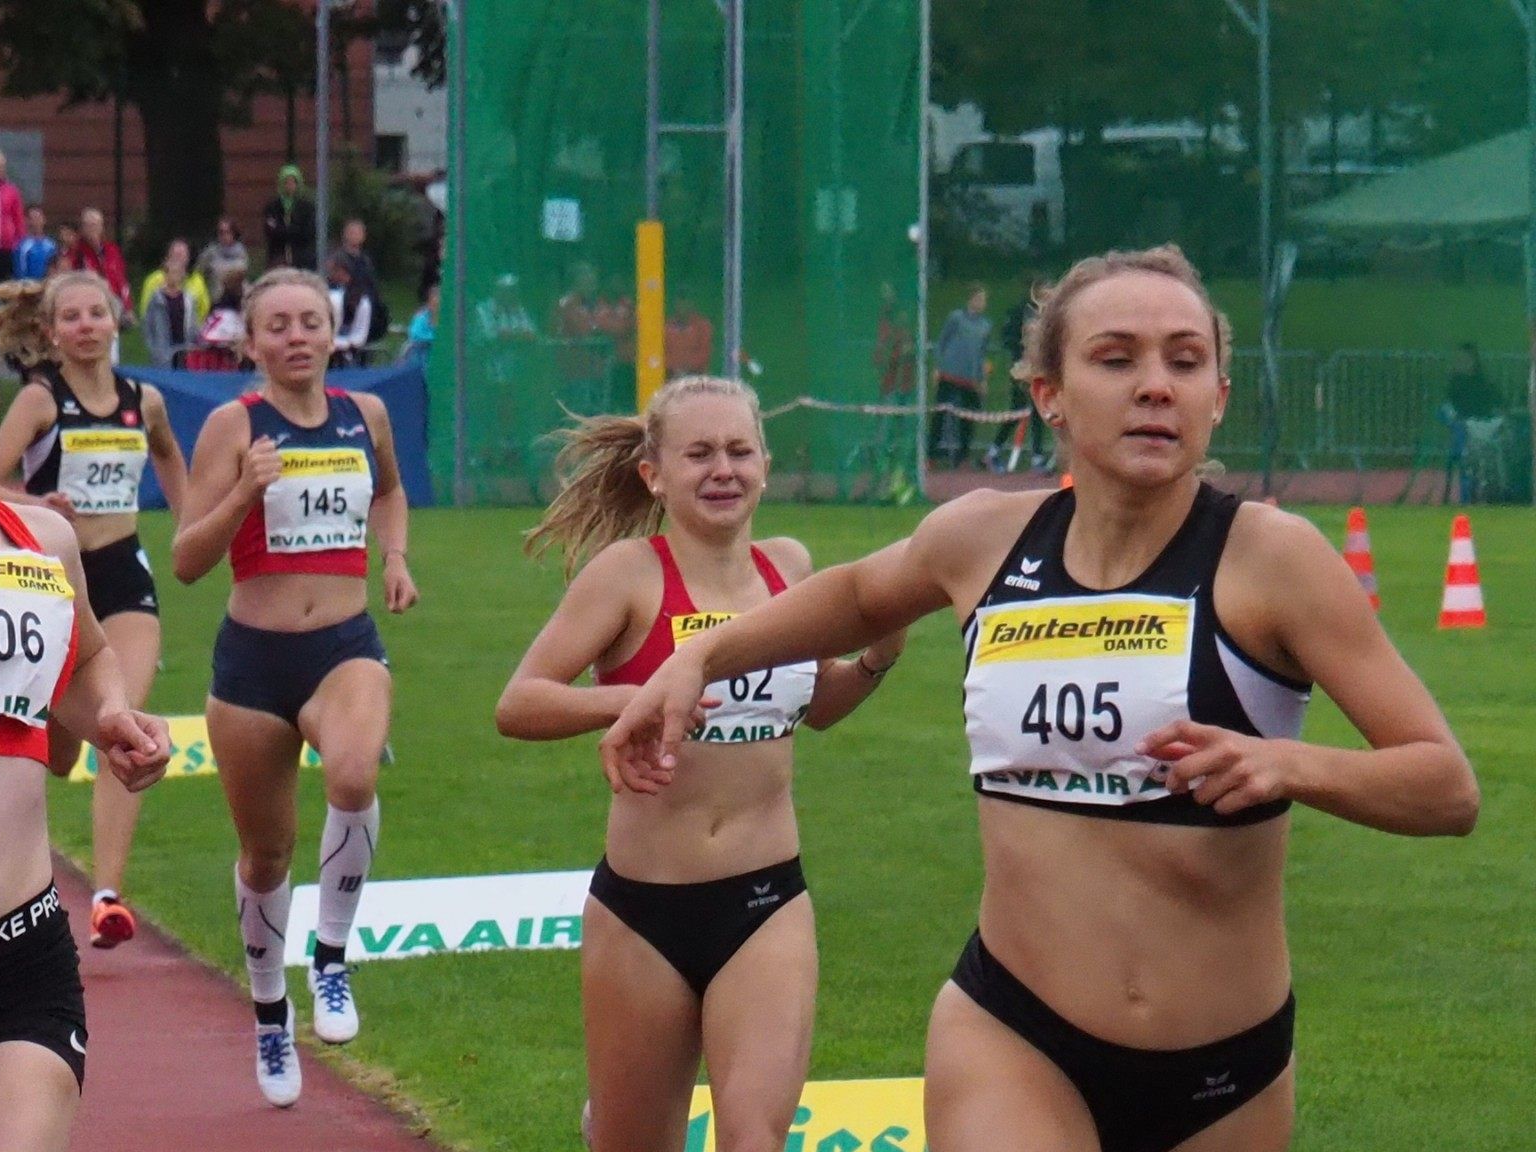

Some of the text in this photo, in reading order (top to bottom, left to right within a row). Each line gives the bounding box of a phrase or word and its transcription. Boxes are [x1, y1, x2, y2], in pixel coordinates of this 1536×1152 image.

[86, 463, 126, 487] 205
[71, 500, 92, 509] VA
[299, 487, 348, 517] 145
[1004, 574, 1041, 592] erima
[989, 614, 1171, 645] fahrtechnik
[1021, 681, 1124, 745] 405
